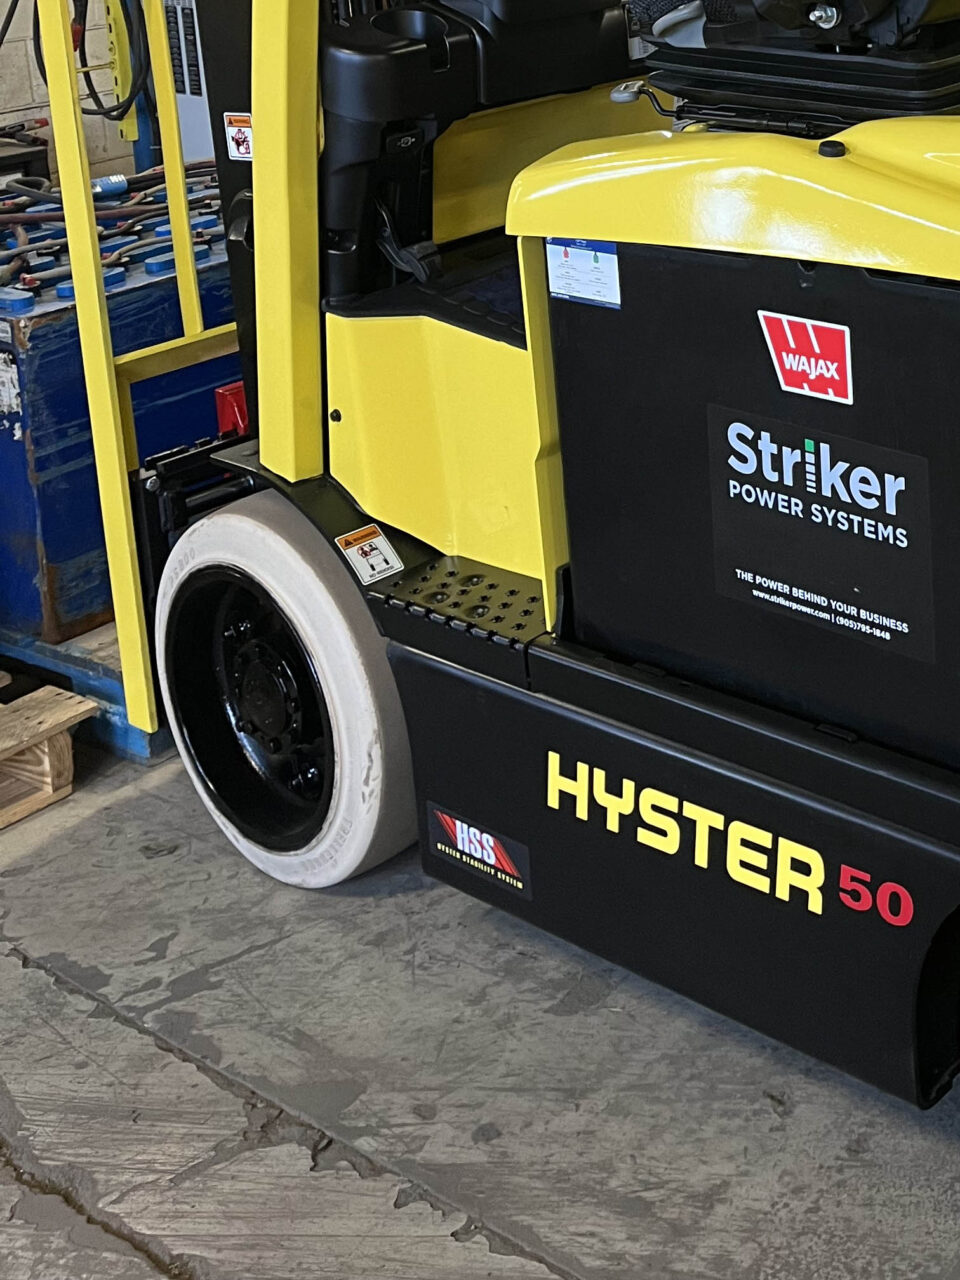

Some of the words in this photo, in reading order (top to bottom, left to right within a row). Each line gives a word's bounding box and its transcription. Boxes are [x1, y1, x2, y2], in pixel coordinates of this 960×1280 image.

[781, 351, 840, 381] WAJAX
[727, 422, 906, 516] Striker
[729, 479, 804, 519] POWER
[810, 503, 909, 549] SYSTEMS
[735, 568, 754, 583] THE
[755, 575, 790, 595] POWER
[791, 587, 828, 607] BEHIND
[829, 599, 858, 618] YOUR
[859, 609, 909, 634] BUSINESS
[751, 589, 831, 621] www.strikerpower.com
[455, 819, 497, 866] HSS
[461, 854, 496, 876] STABILITY
[547, 751, 825, 916] HYSTER
[838, 864, 914, 927] 50
